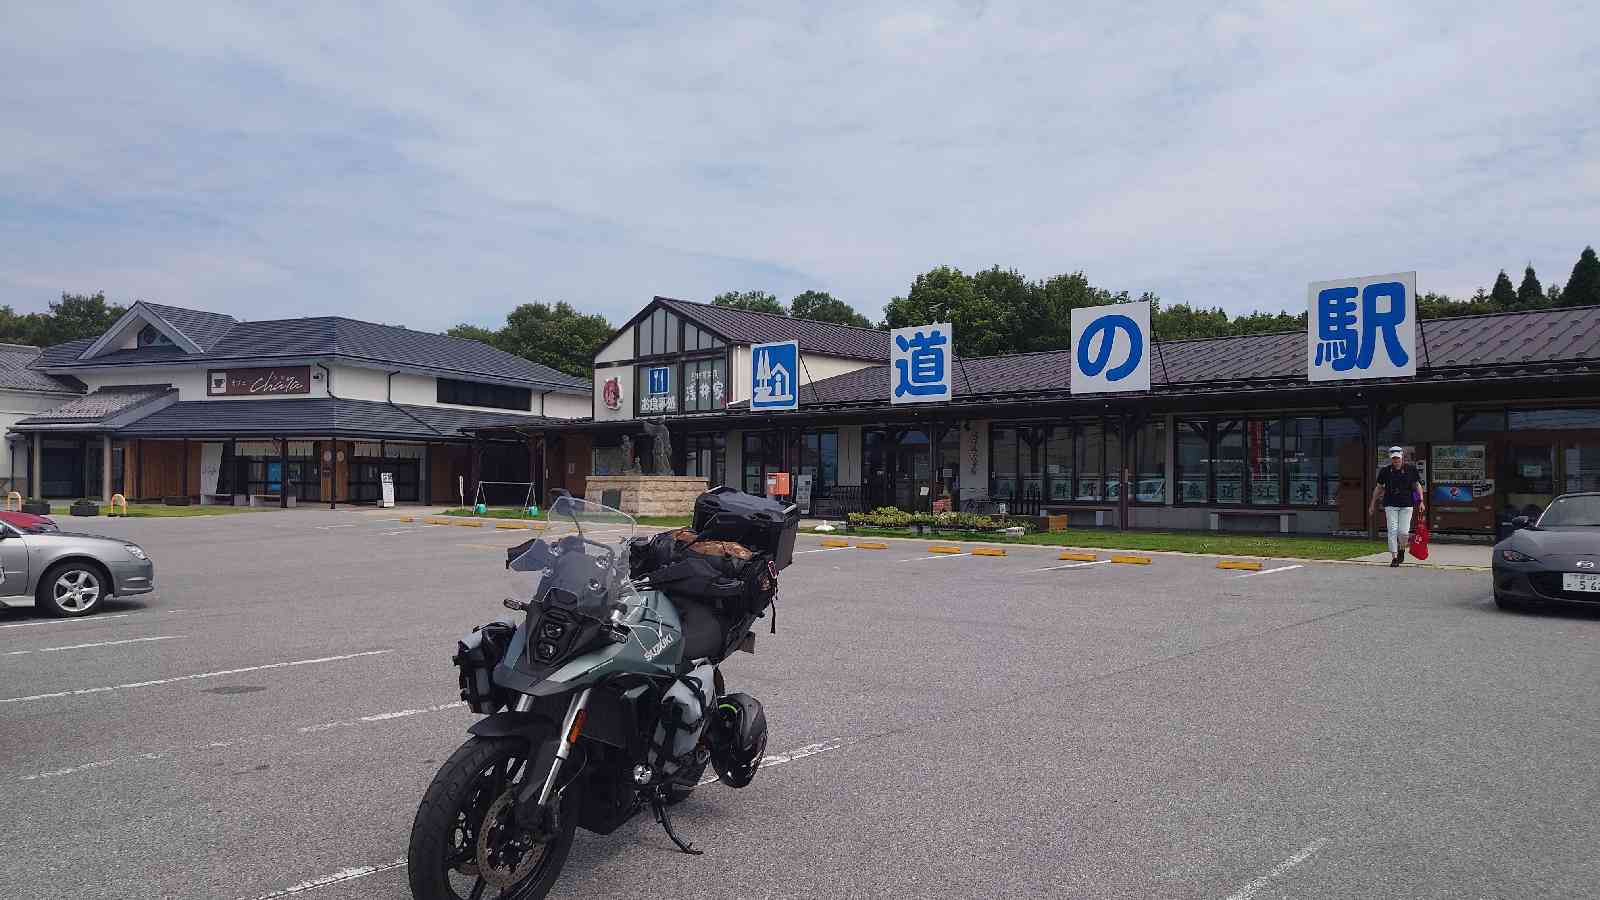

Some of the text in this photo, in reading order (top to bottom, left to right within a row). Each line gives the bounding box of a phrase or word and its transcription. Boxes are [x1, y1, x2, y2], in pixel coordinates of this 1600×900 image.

[895, 282, 1408, 397] 道 の 駅
[643, 632, 673, 662] SUZUKI
